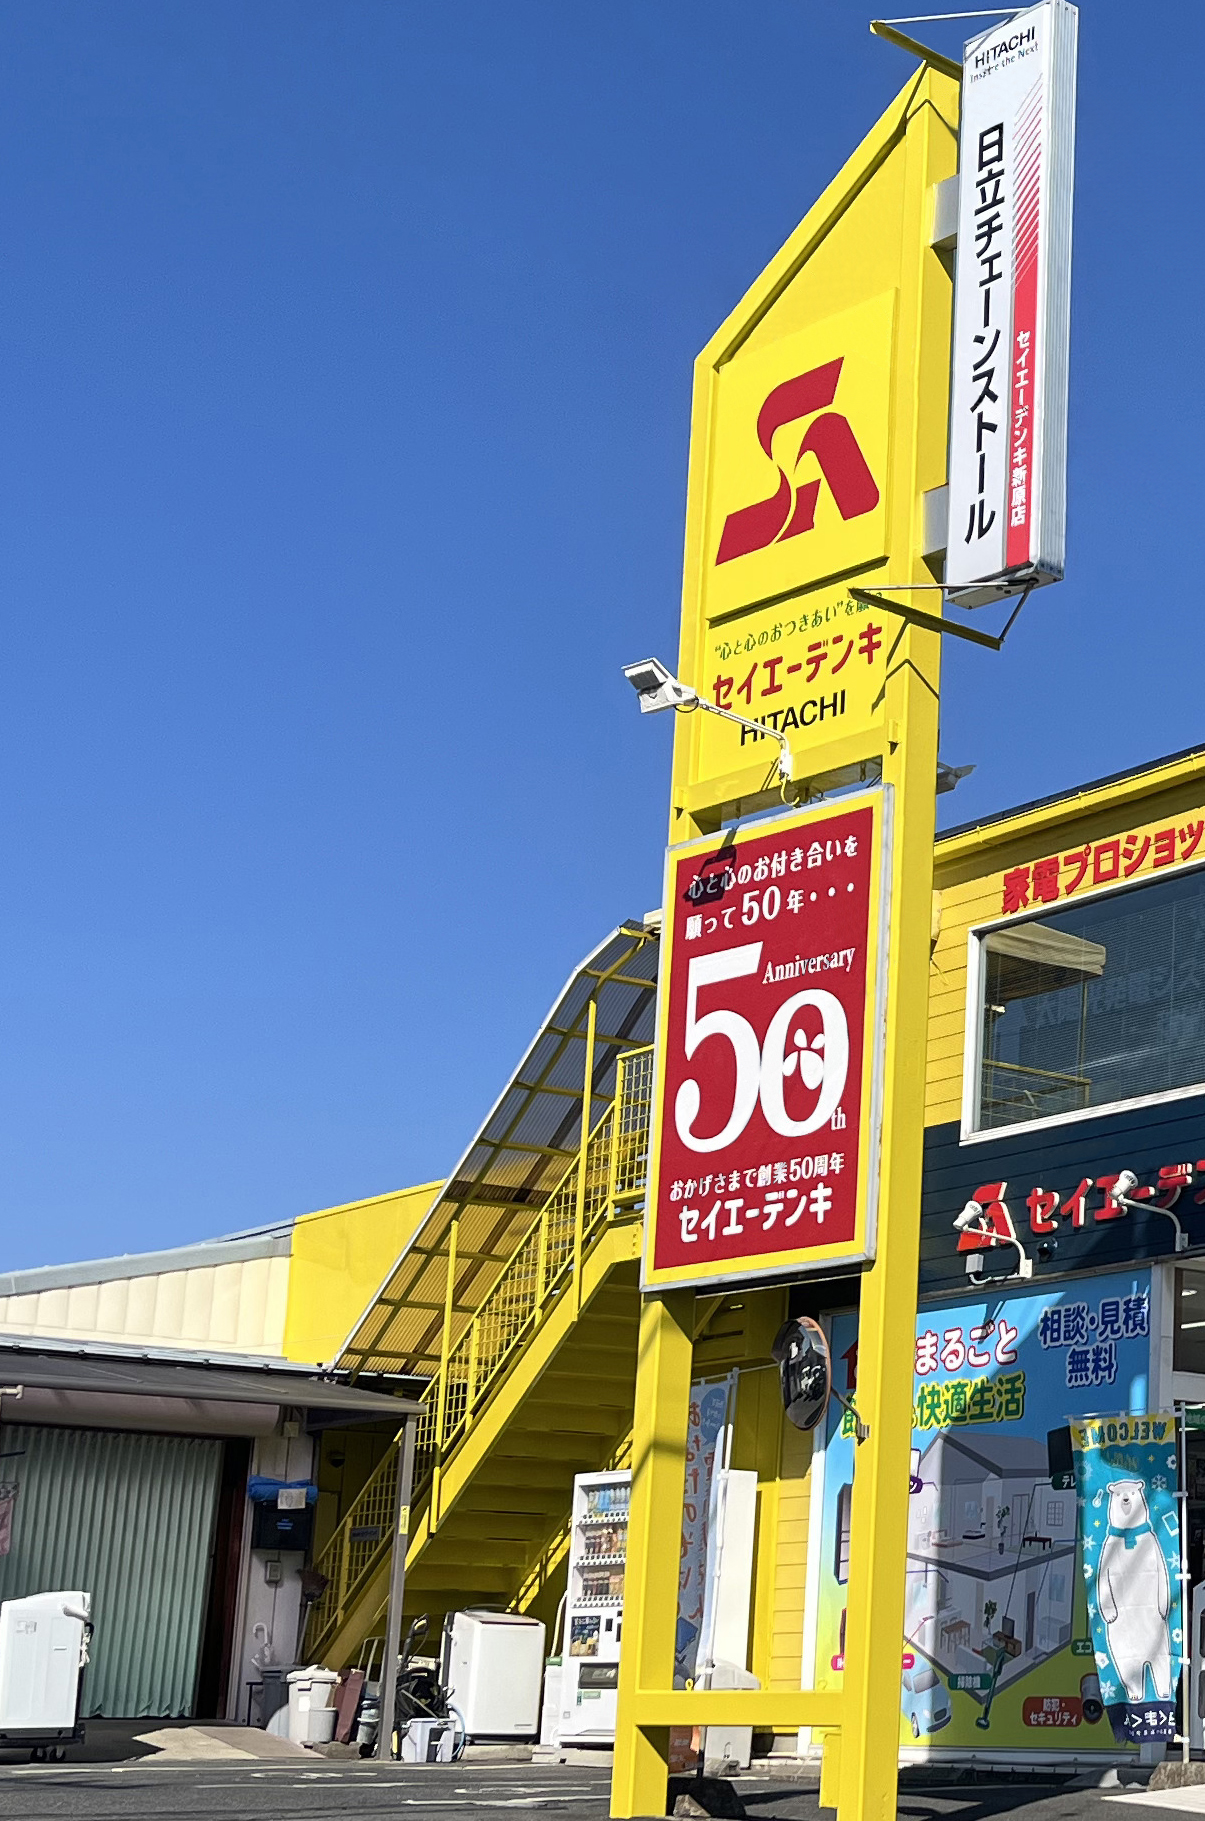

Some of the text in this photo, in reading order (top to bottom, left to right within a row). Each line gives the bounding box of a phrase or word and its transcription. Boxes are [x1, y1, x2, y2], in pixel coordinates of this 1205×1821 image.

[974, 25, 1036, 69] HITACHI
[1018, 42, 1039, 60] Next
[712, 622, 883, 711] セイエーデンキ
[740, 689, 846, 747] HITACHI
[688, 834, 860, 901] 心と心のお付き合いを
[762, 946, 857, 985] Anniversary
[674, 941, 850, 1153] 50
[830, 1106, 847, 1131] th
[669, 1152, 846, 1202] おかげさまで創業50周年
[679, 1183, 834, 1244] セイエーデンキ
[914, 1318, 1019, 1376] まるごと
[1038, 1296, 1151, 1349] 相談・見積
[1066, 1343, 1118, 1388] 無料
[1030, 1711, 1078, 1725] セキュリティ
